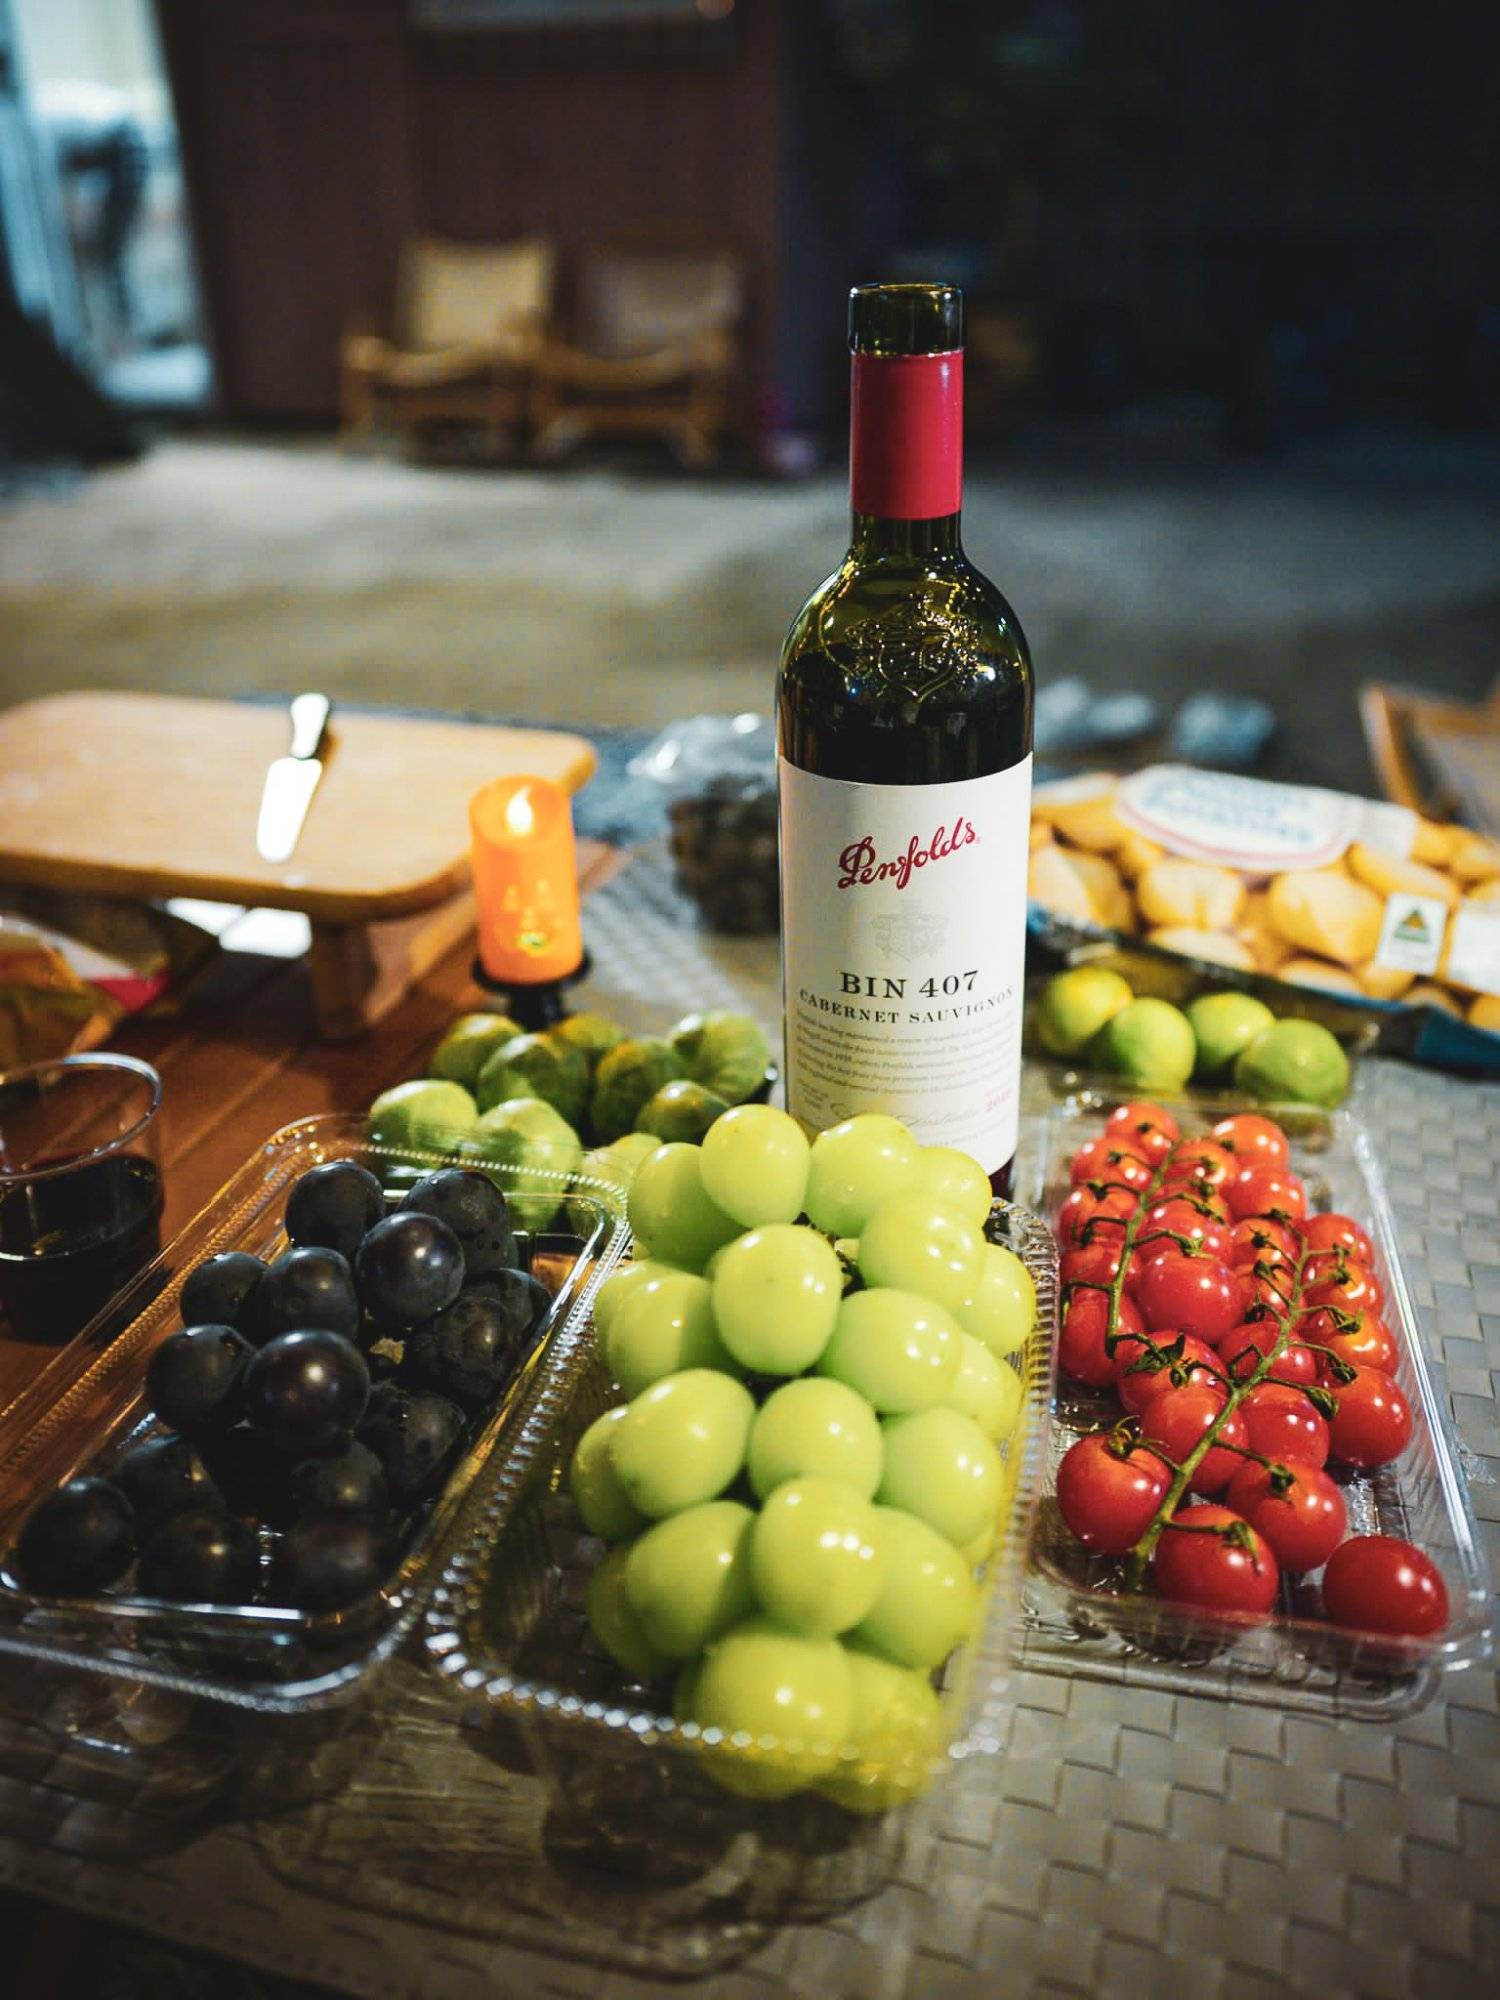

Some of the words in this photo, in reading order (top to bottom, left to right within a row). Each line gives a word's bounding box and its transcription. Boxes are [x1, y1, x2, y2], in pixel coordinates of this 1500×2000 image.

[837, 816, 976, 890] Penfolds
[839, 971, 907, 999] BIN
[918, 969, 979, 998] 407
[800, 988, 899, 1024] CABERNET
